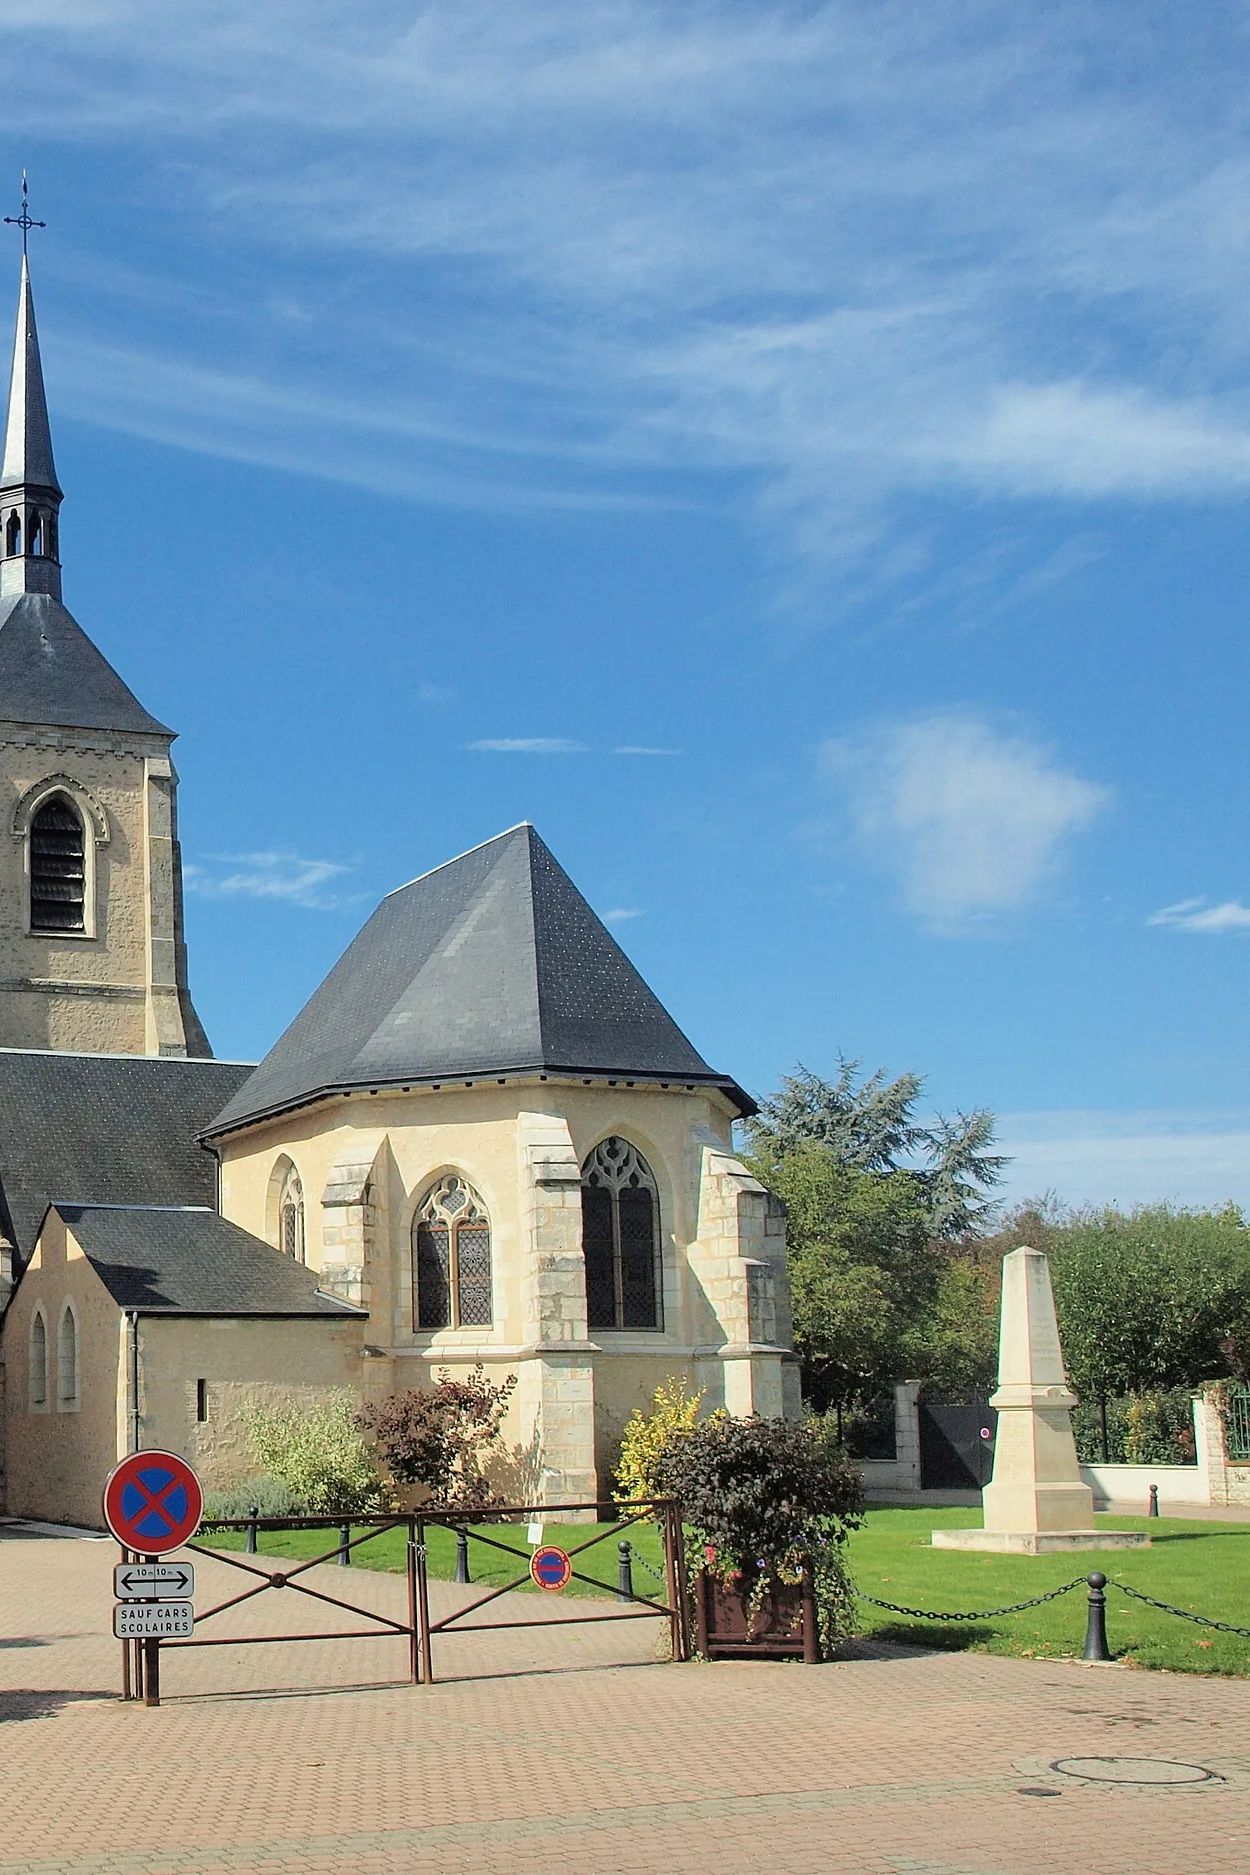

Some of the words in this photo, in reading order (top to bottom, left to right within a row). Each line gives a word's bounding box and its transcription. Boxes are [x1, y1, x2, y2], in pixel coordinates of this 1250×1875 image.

[137, 1568, 147, 1576] 10
[156, 1568, 167, 1576] 10
[121, 1609, 152, 1619] SAUF
[157, 1608, 188, 1618] CARS
[121, 1622, 188, 1633] SCOLAIRES
